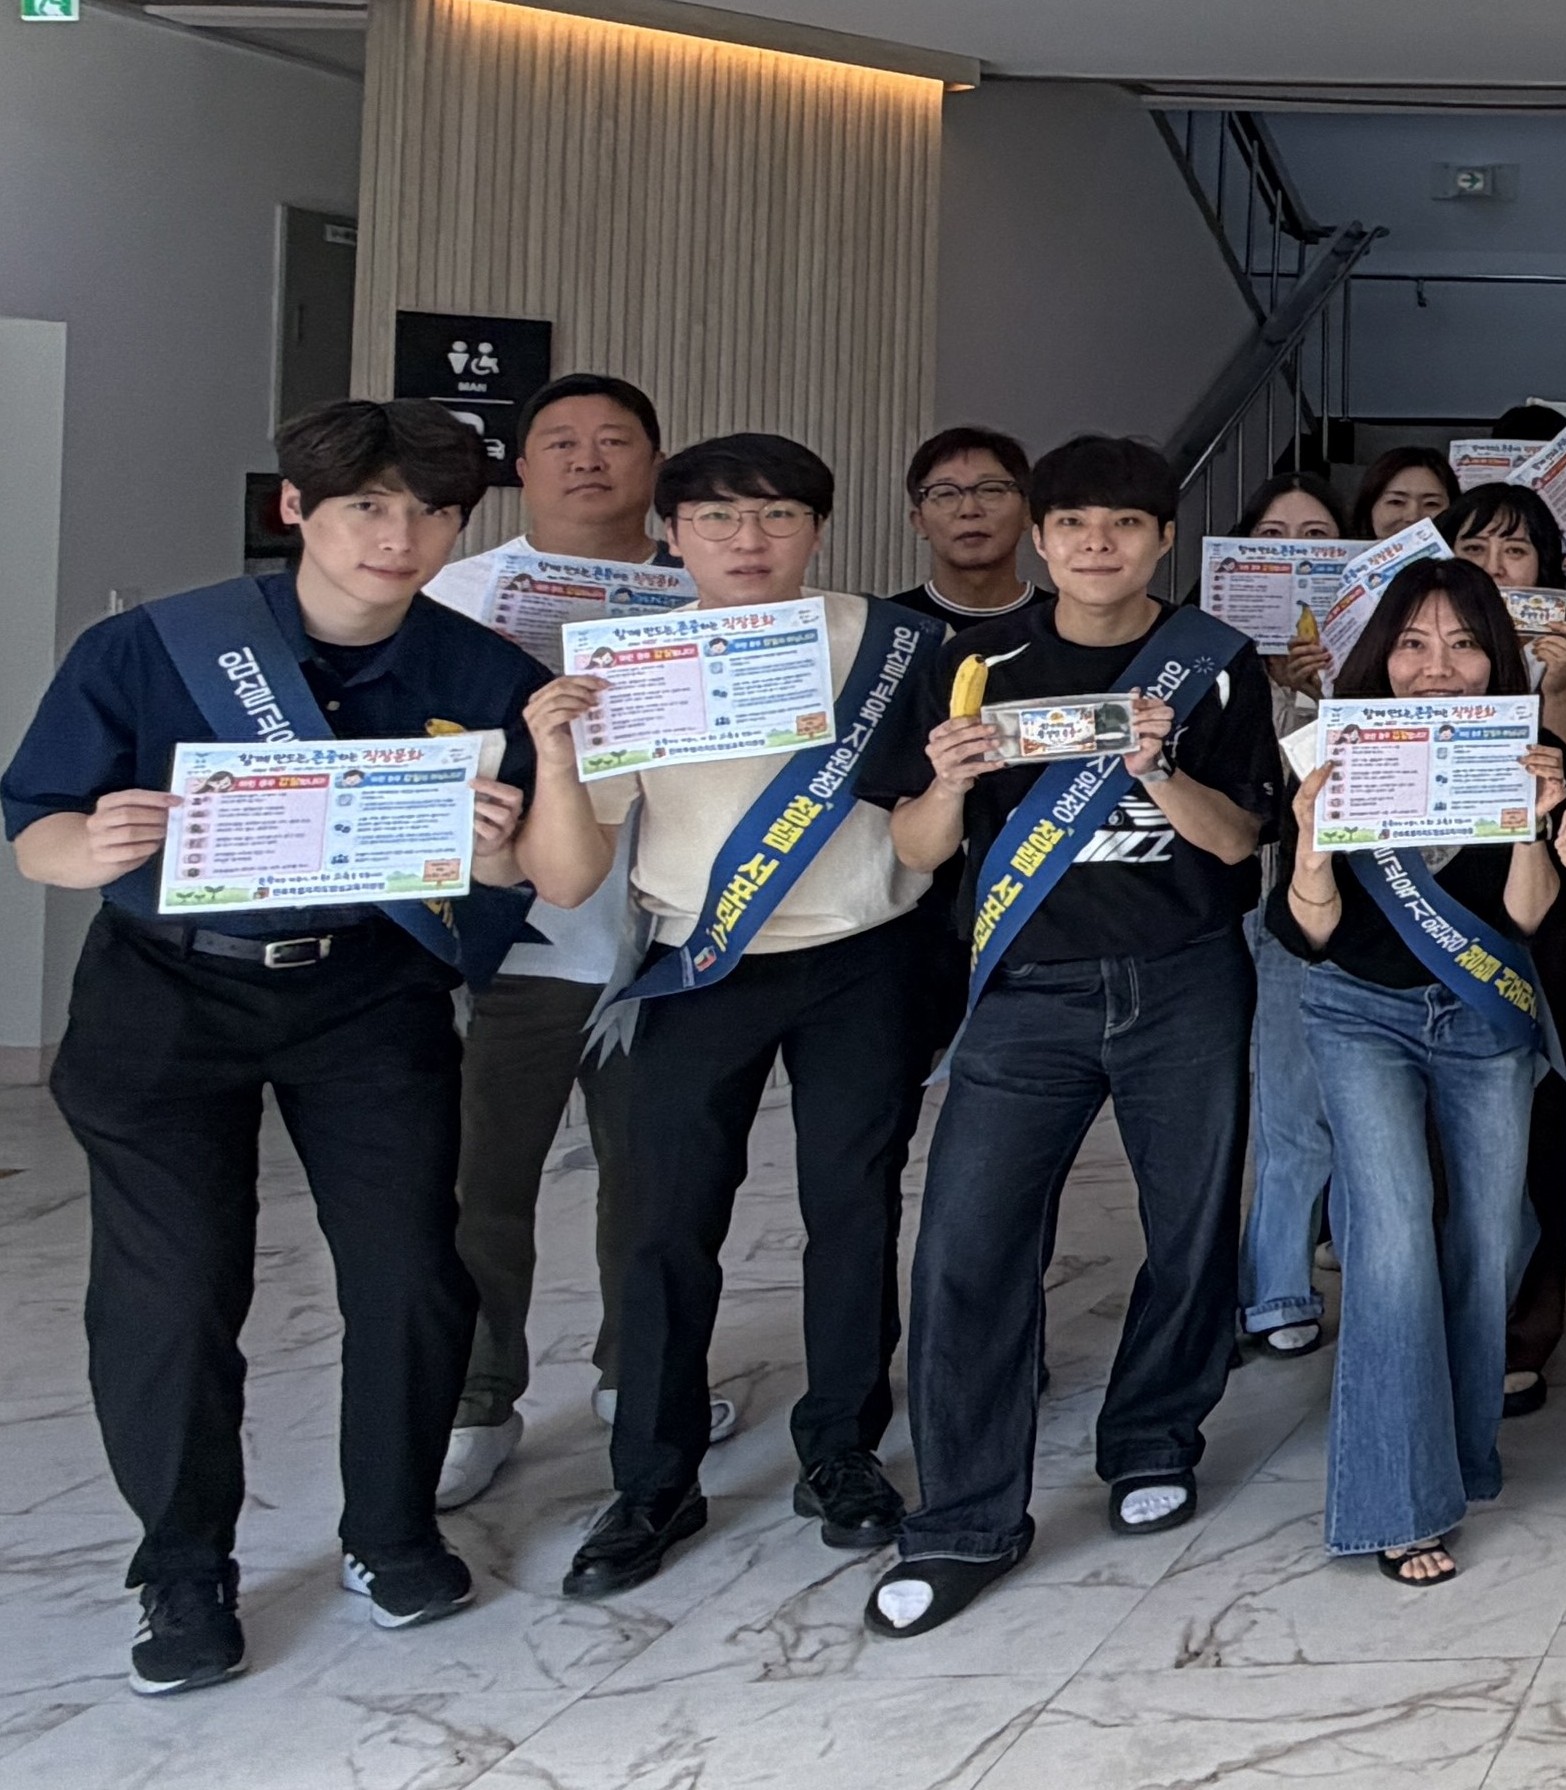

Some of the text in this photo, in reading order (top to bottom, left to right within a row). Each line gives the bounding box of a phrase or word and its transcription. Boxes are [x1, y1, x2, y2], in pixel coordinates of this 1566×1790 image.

[808, 625, 920, 799] 임실교육지원청
[238, 752, 272, 767] 함께
[310, 750, 358, 763] 존중하는
[362, 748, 424, 763] 직장문화
[762, 794, 823, 855] 청렴
[1010, 818, 1066, 877] 청렴
